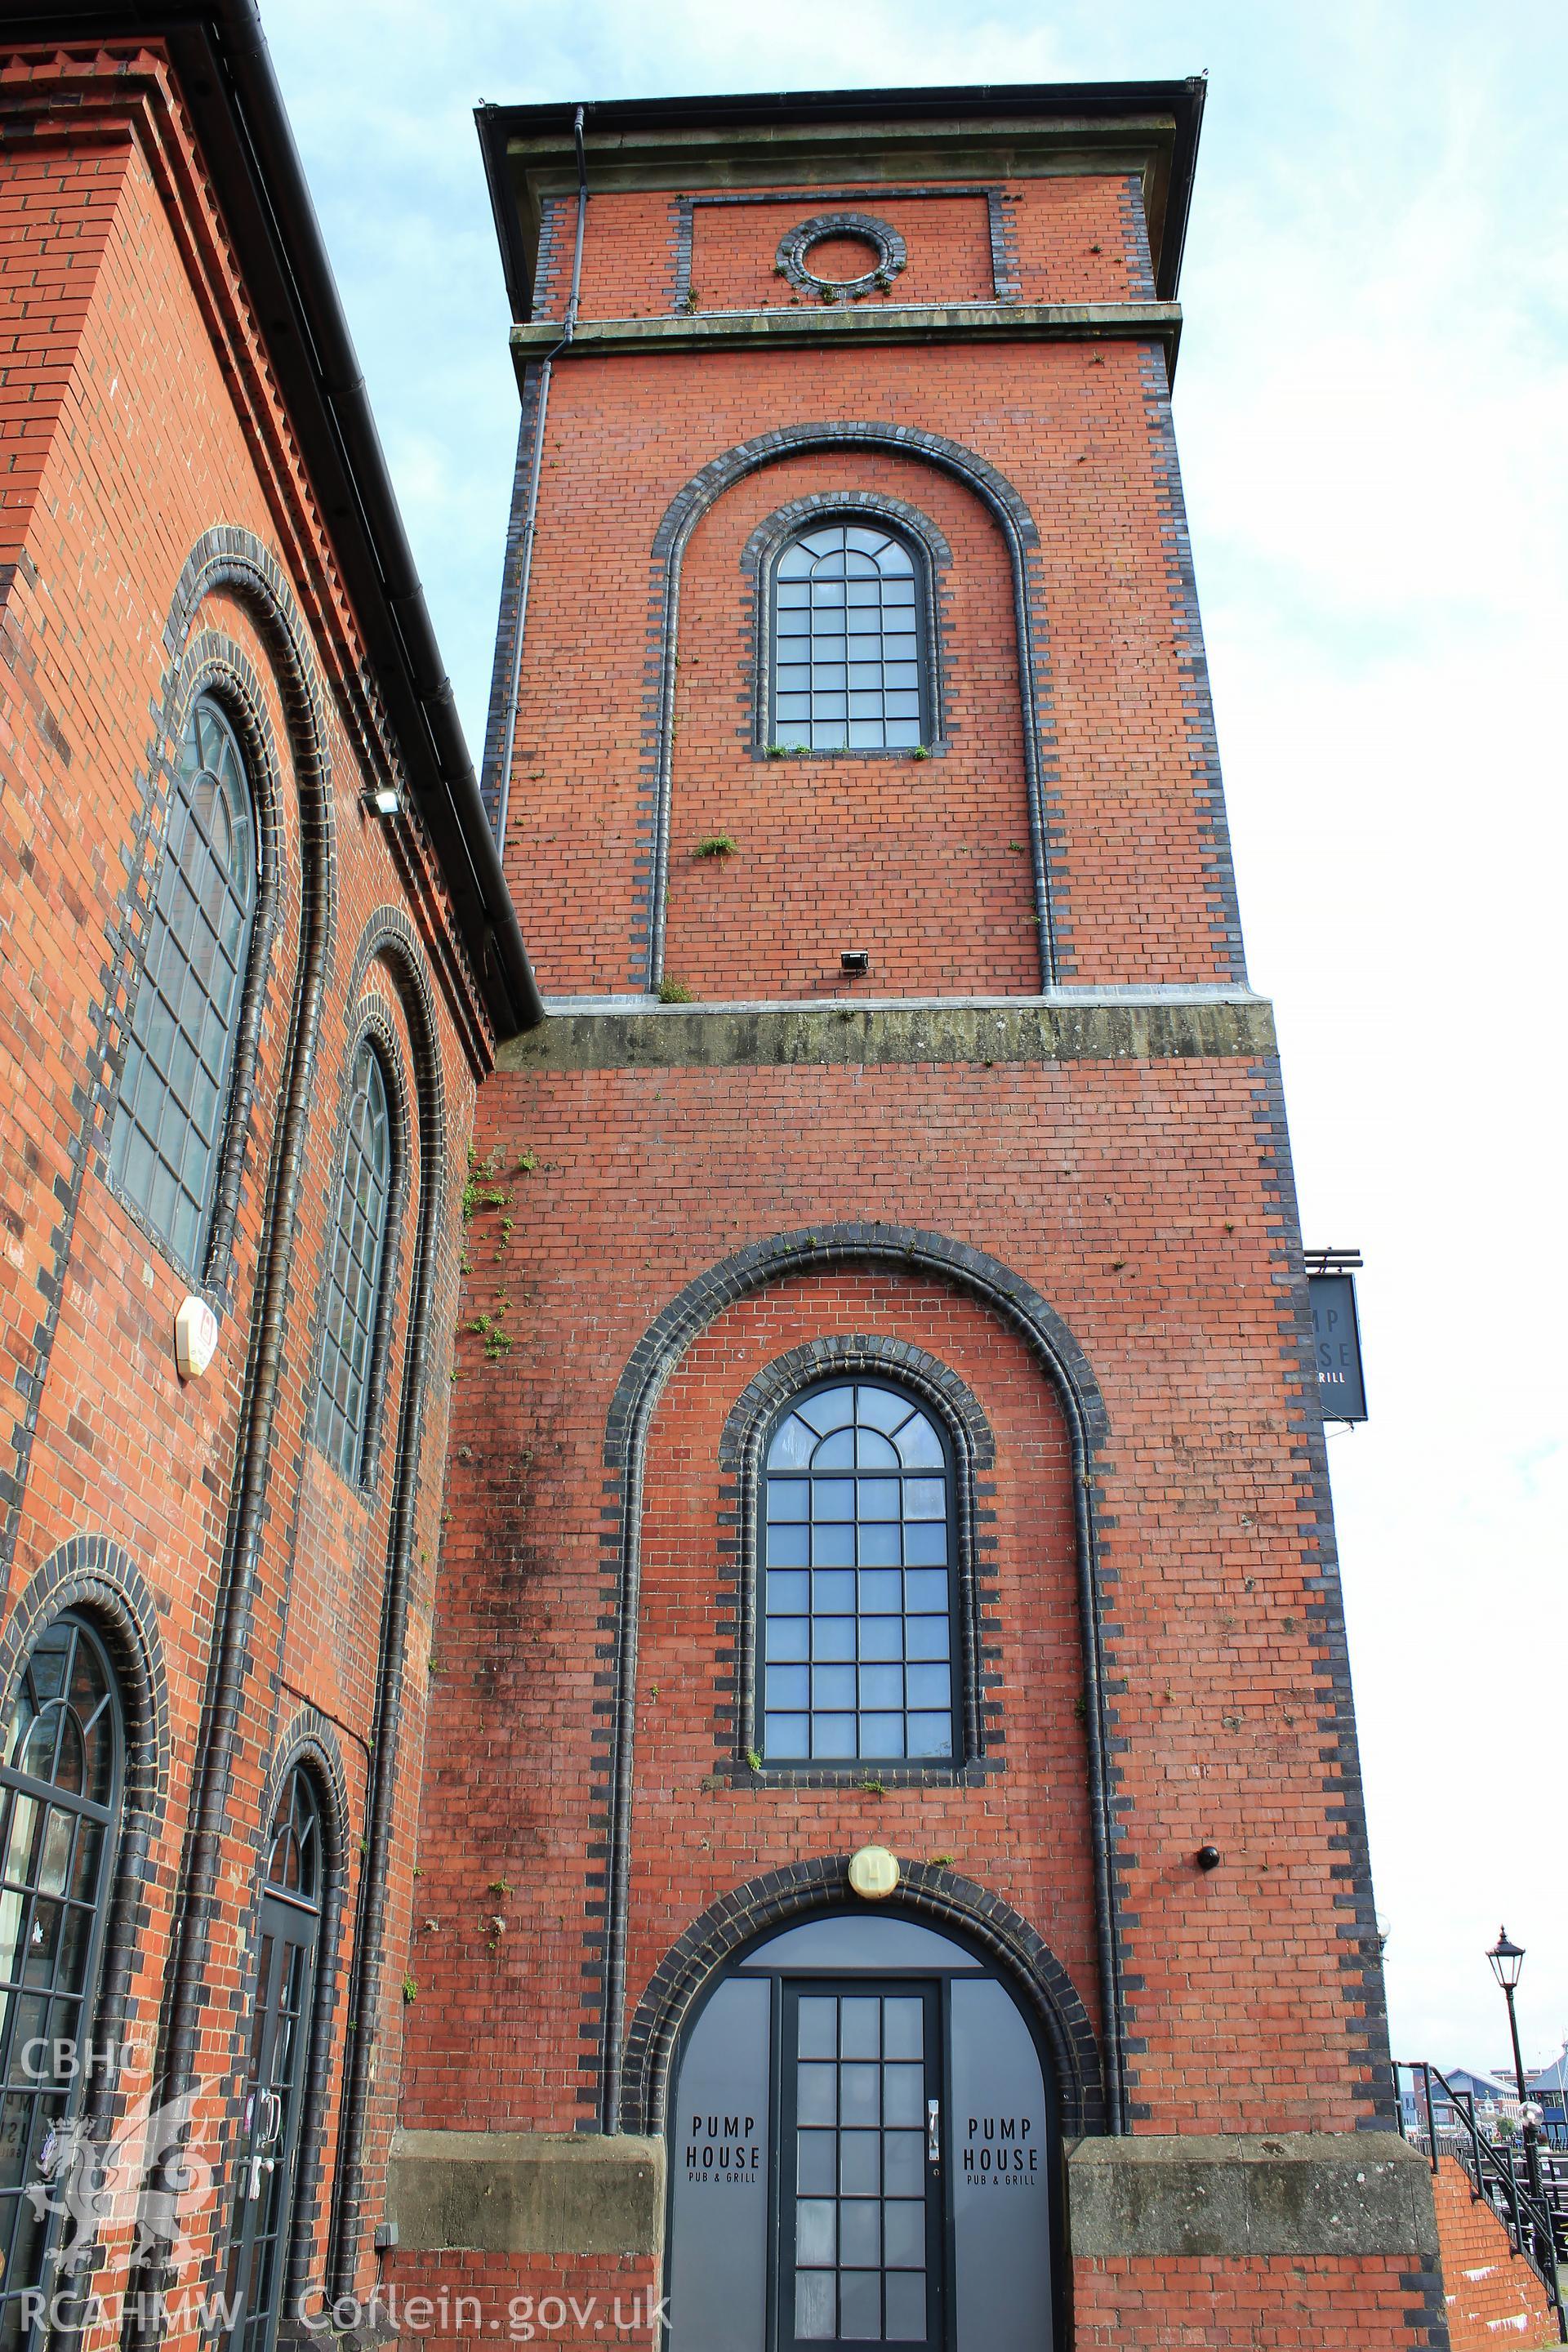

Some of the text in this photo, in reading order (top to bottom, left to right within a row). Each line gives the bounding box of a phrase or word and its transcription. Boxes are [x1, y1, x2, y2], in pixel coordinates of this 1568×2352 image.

[1318, 1372, 1345, 1383] RILL
[693, 2116, 755, 2138] PUMP
[969, 2118, 1031, 2140] PUMP
[686, 2146, 759, 2168] HOUSE
[964, 2149, 1038, 2171] HOUSE
[688, 2172, 755, 2183] PUB & GRILL
[967, 2175, 1035, 2185] PUB & GRILL
